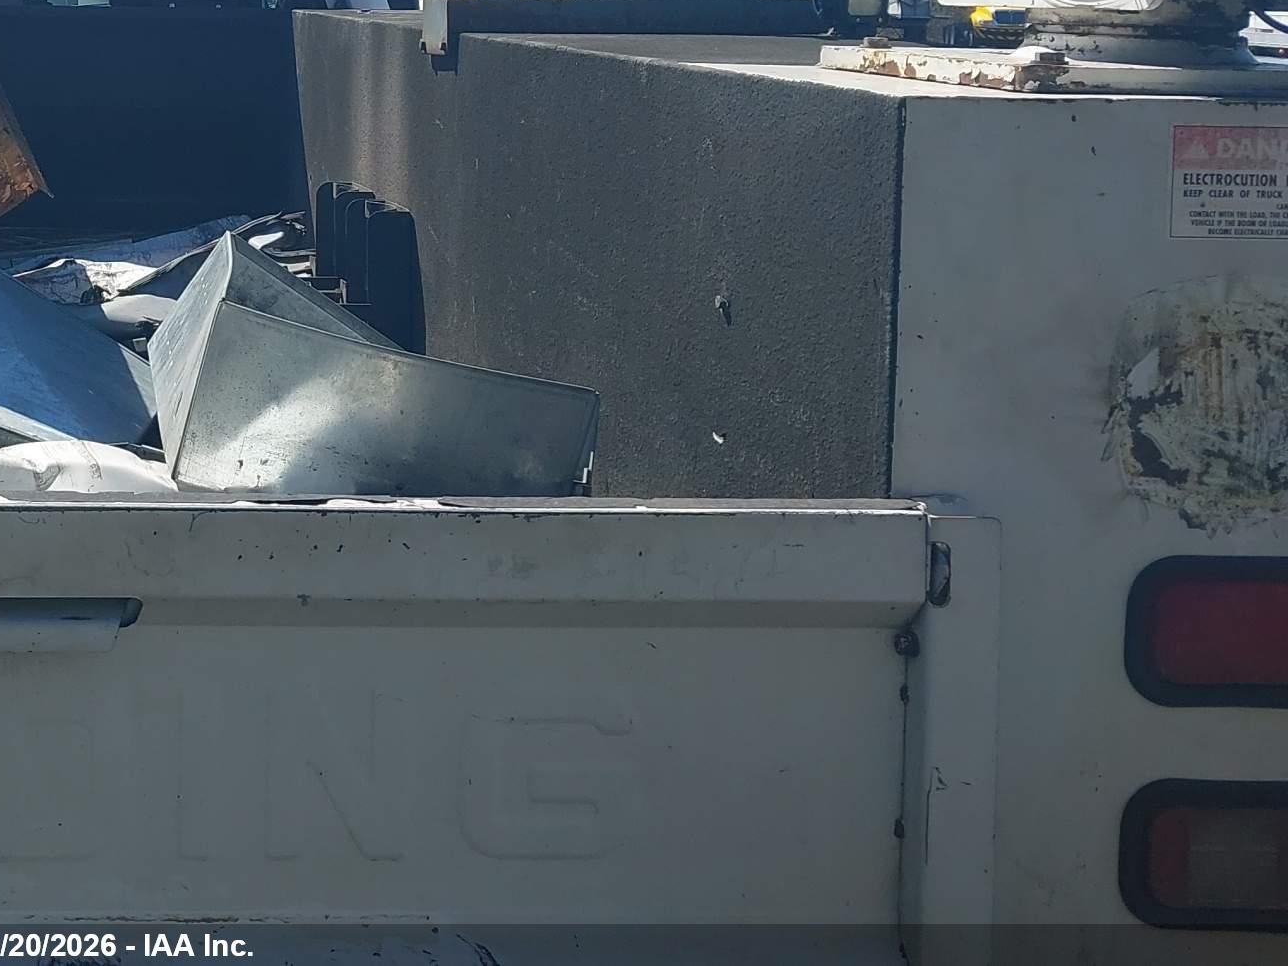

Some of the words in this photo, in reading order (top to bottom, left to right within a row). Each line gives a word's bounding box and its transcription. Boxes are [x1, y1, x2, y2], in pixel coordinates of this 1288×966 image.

[1183, 172, 1278, 187] ELECTROCUTION
[1183, 189, 1203, 198] KEEP
[1208, 189, 1234, 198] CLEAR
[1239, 189, 1250, 198] OF
[1256, 190, 1284, 199] TRUCK
